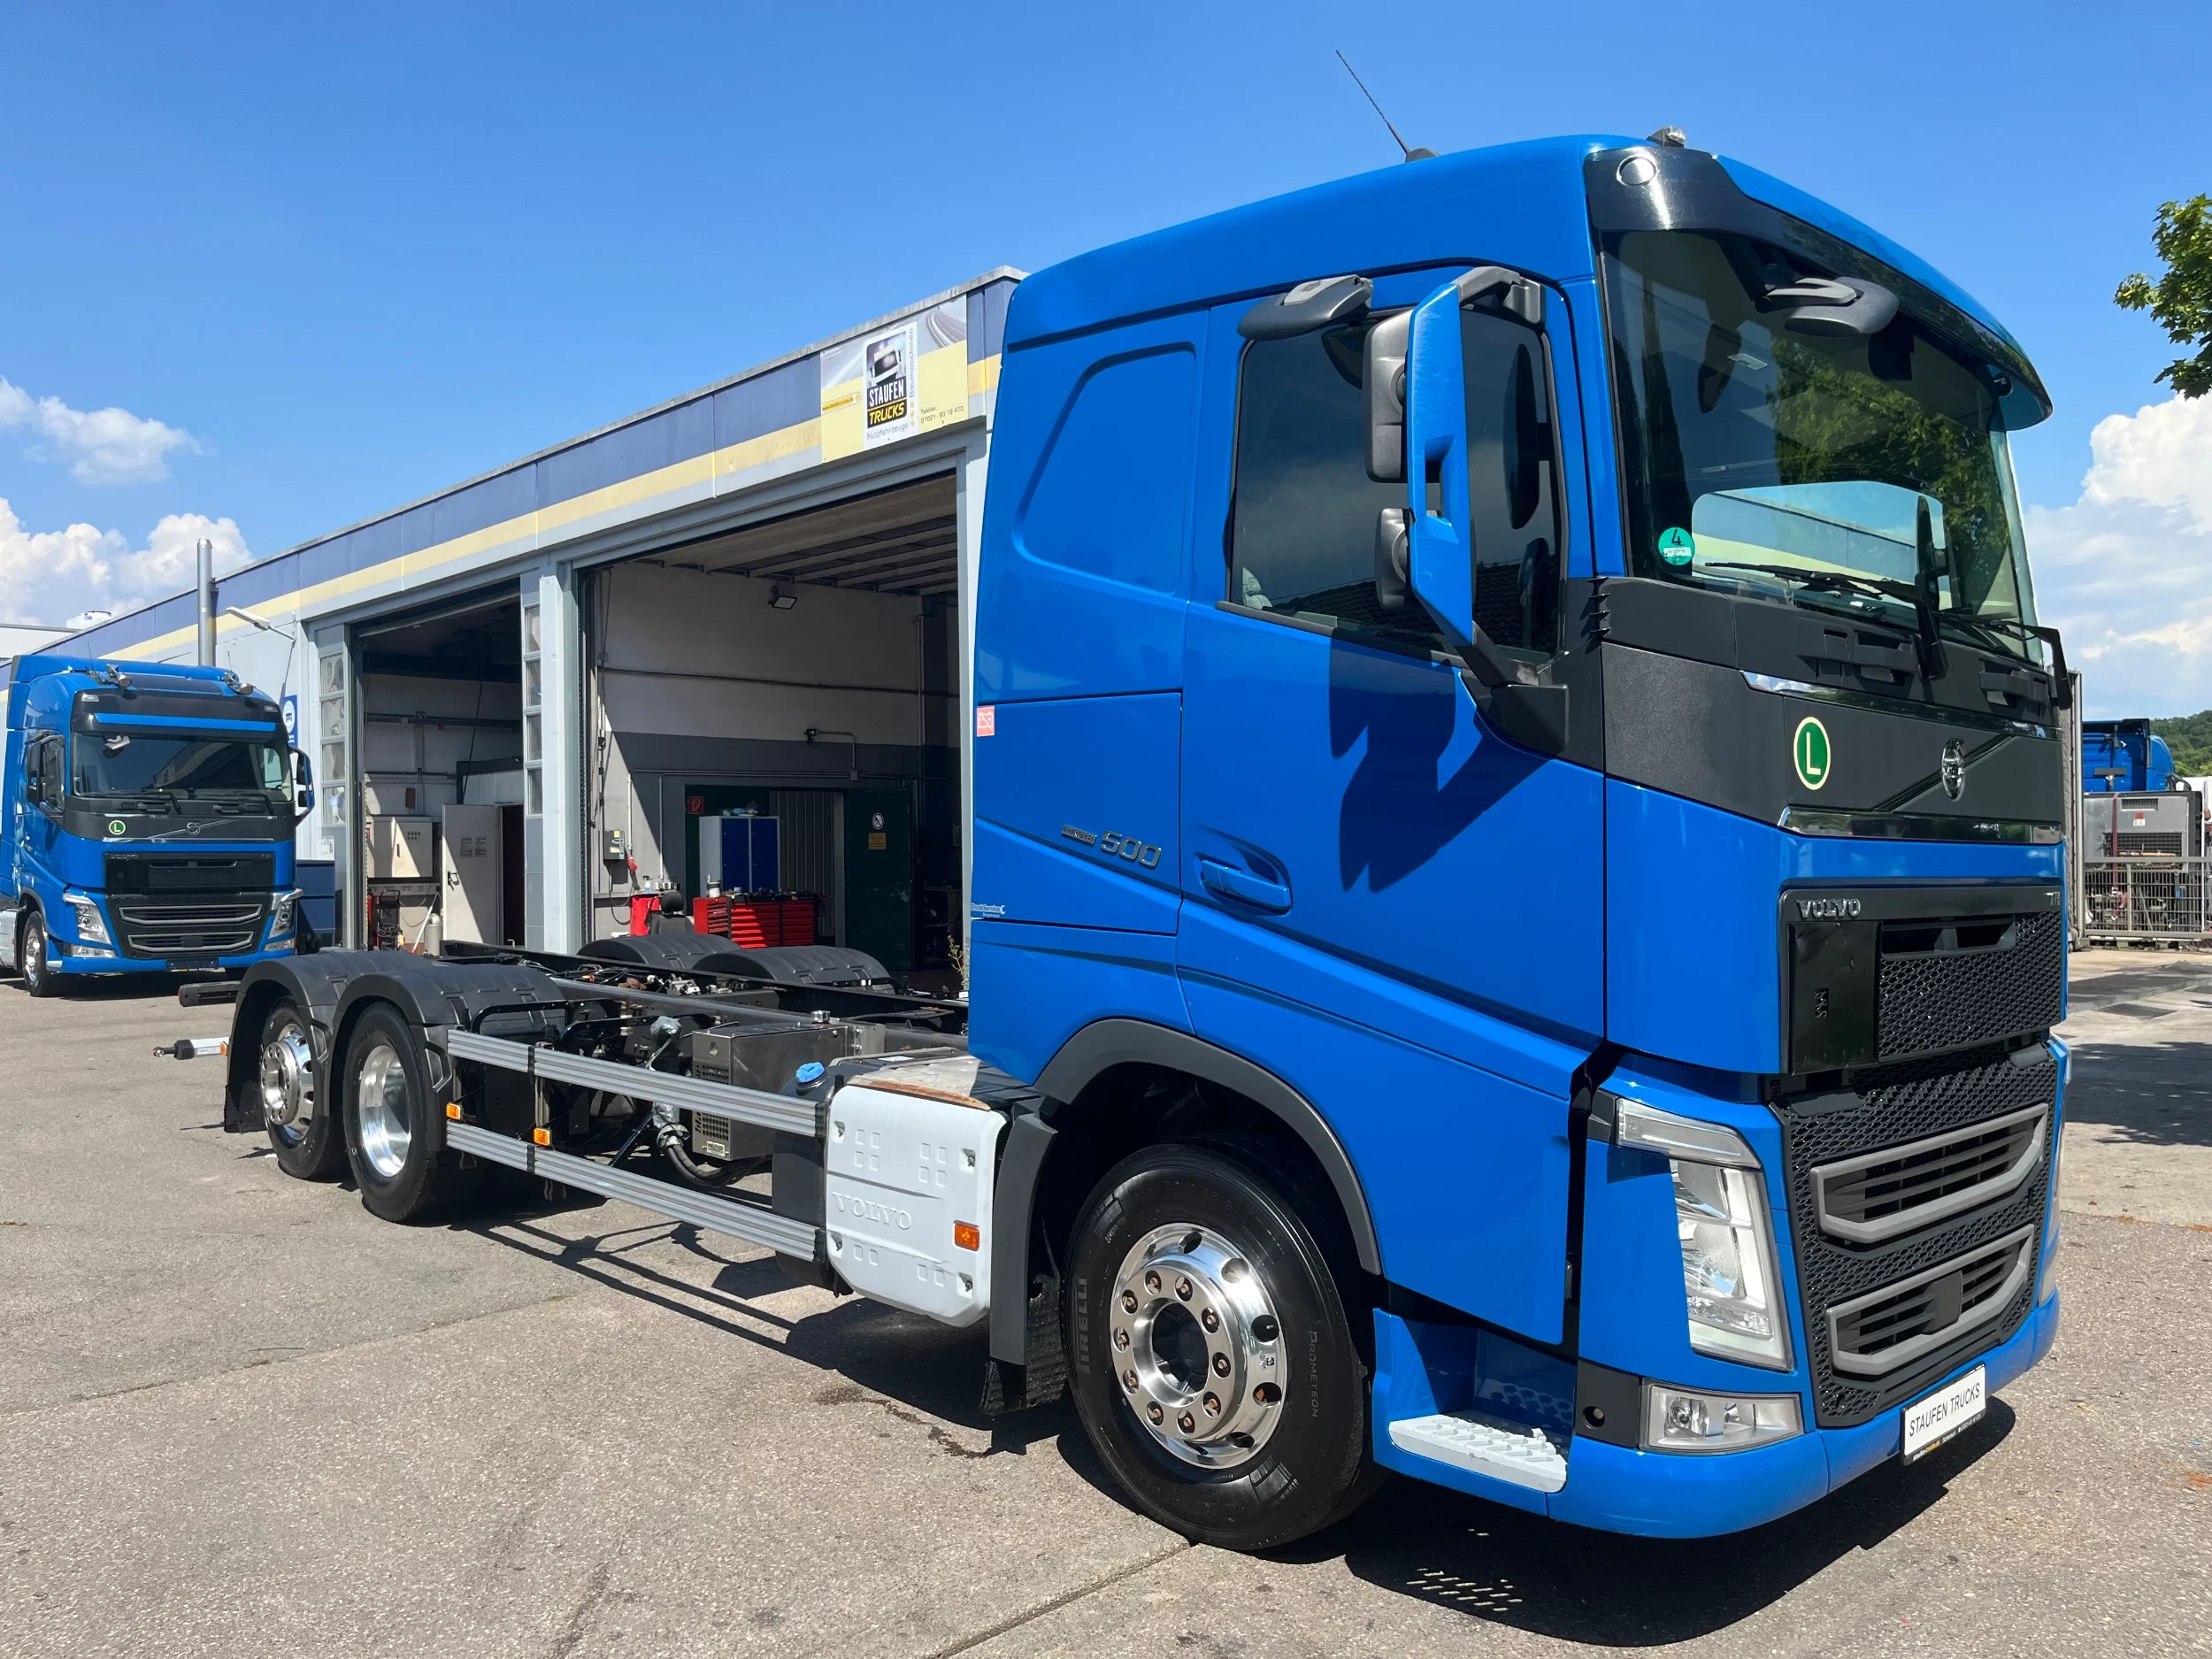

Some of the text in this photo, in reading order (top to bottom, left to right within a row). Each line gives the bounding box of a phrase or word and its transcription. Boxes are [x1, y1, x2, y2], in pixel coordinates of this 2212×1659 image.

[869, 379, 905, 408] STAUFEN
[869, 402, 905, 425] TRUCKS
[867, 422, 909, 440] Nutzfahrzeuge
[1671, 528, 1682, 546] 4
[1806, 732, 1821, 776] L
[113, 822, 122, 833] L
[1100, 830, 1162, 867] 500
[1794, 898, 1861, 918] VOLVO
[832, 1191, 912, 1231] VOLVO
[1308, 1330, 1319, 1417] PROMETEON
[1909, 1401, 1947, 1437] STAUFEN
[1950, 1382, 1980, 1414] TRUCKS
